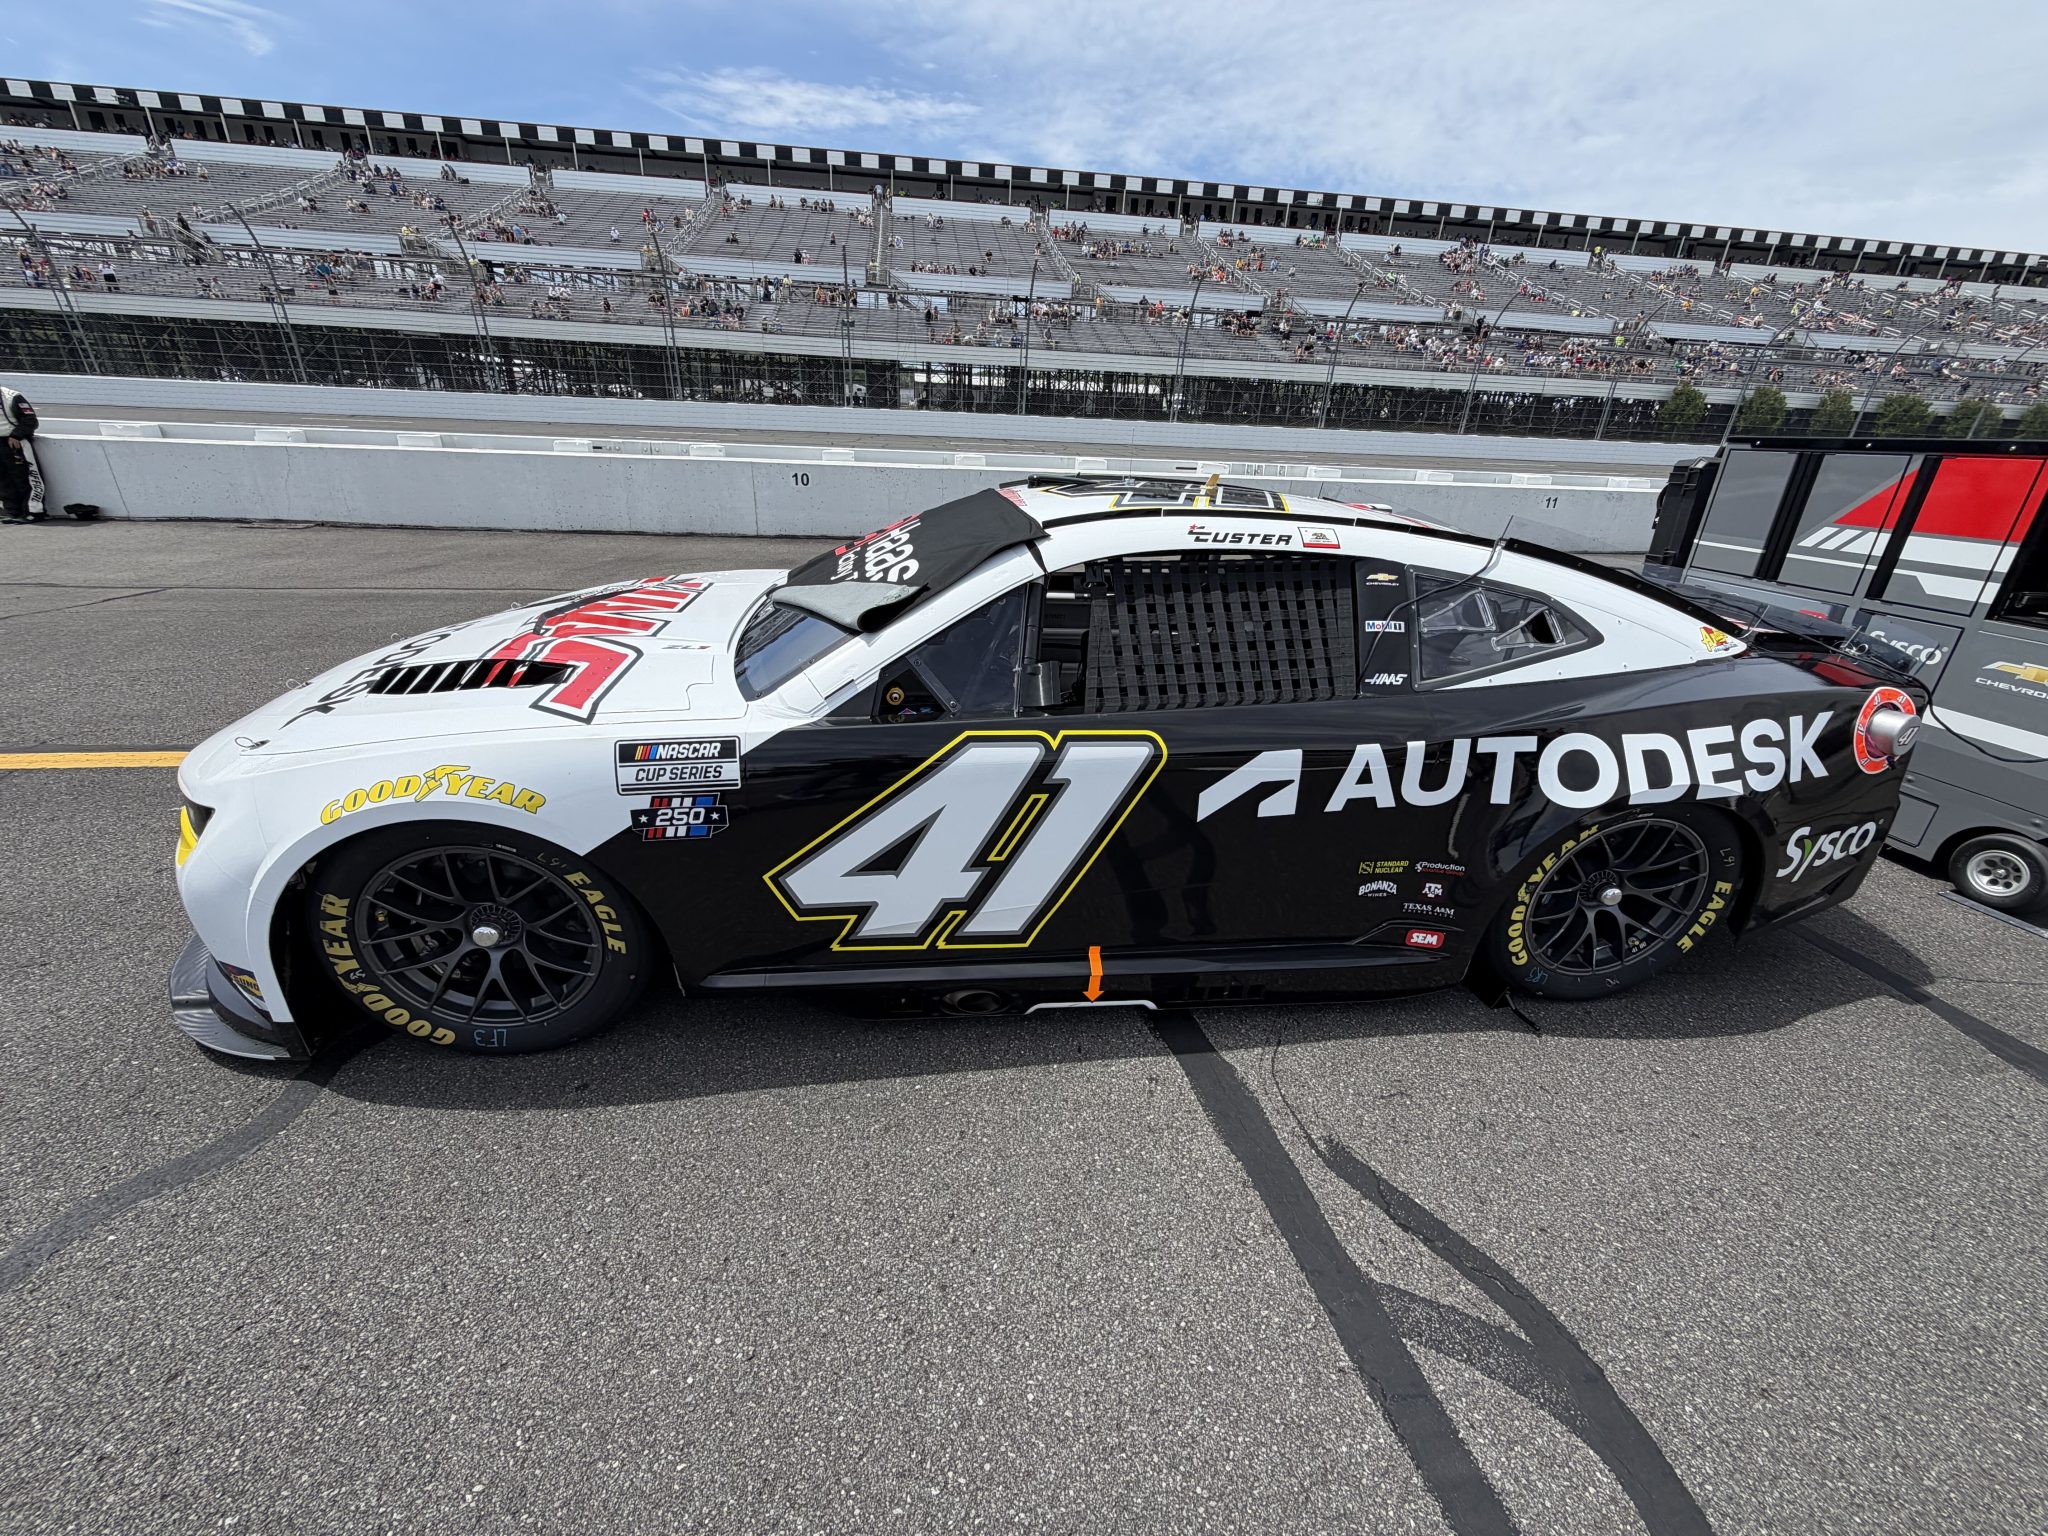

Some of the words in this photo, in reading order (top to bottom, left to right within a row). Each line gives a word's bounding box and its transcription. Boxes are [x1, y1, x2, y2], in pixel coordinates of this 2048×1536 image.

[791, 472, 810, 487] 10
[1545, 496, 1559, 509] 11
[1188, 524, 1293, 546] CUSTER
[1365, 673, 1408, 686] HAAS
[1975, 677, 2048, 701] CHEVRO
[1898, 726, 1920, 746] 41
[655, 742, 722, 760] NASCAR
[1323, 711, 1835, 812] AUTODESK
[634, 766, 667, 782] CUP
[668, 765, 723, 781] SERIES
[655, 807, 706, 826] 250
[777, 741, 1155, 940] 41
[1421, 861, 1466, 872] Production
[1358, 880, 1398, 896] BONANZA
[563, 871, 627, 955] EAGLE
[1402, 902, 1432, 911] TEXAS
[1433, 906, 1455, 916] A&M
[1676, 880, 1733, 954] EAGLE
[1410, 932, 1438, 945] SEM
[472, 1028, 508, 1048] LF3
